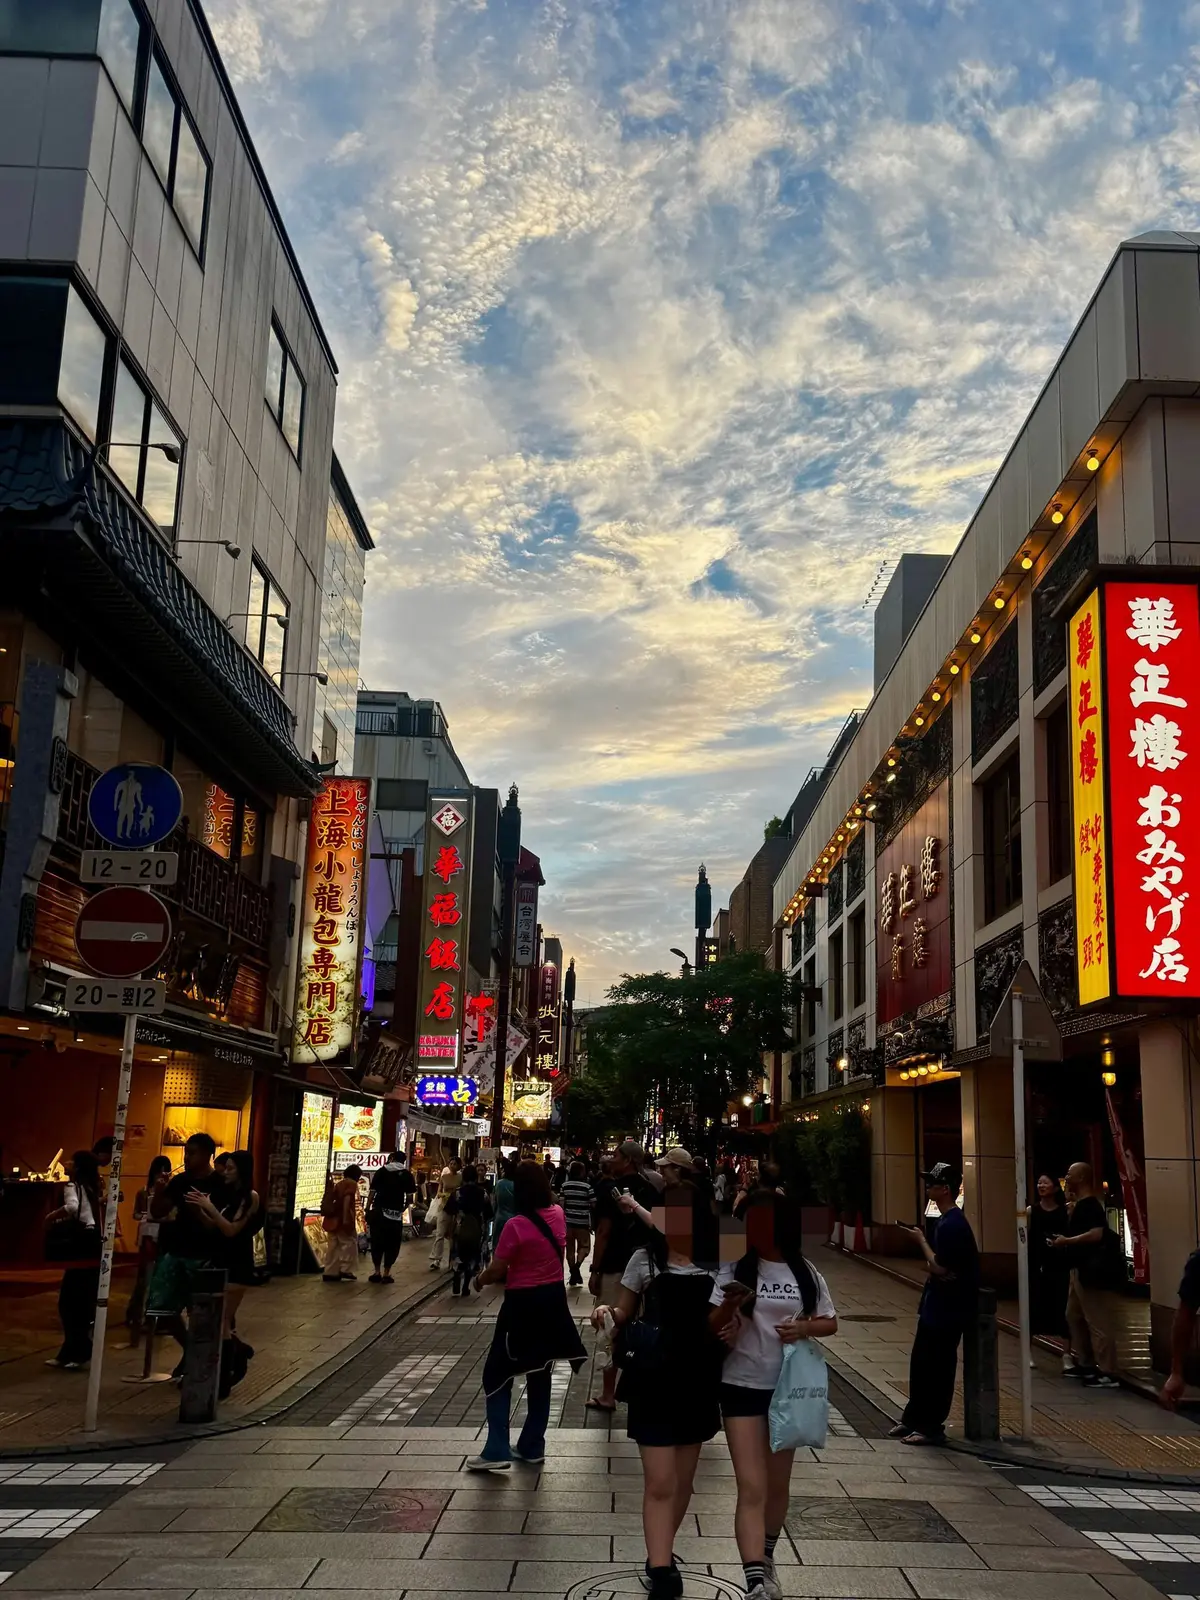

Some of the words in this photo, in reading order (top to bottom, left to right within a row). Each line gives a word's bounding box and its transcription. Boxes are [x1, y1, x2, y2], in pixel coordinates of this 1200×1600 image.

[1076, 611, 1099, 787] 華正樓
[1126, 596, 1188, 772] 華正樓
[351, 788, 367, 851] しゃんはい
[304, 788, 351, 1047] 上海小龍包専門店
[424, 844, 464, 1021] 華福飯店
[518, 905, 533, 956] 台湾屋台
[1136, 784, 1190, 983] おみやげ店
[451, 1078, 472, 1103] 占
[356, 1153, 387, 1167] 2480
[759, 1283, 796, 1294] A.P.C.
